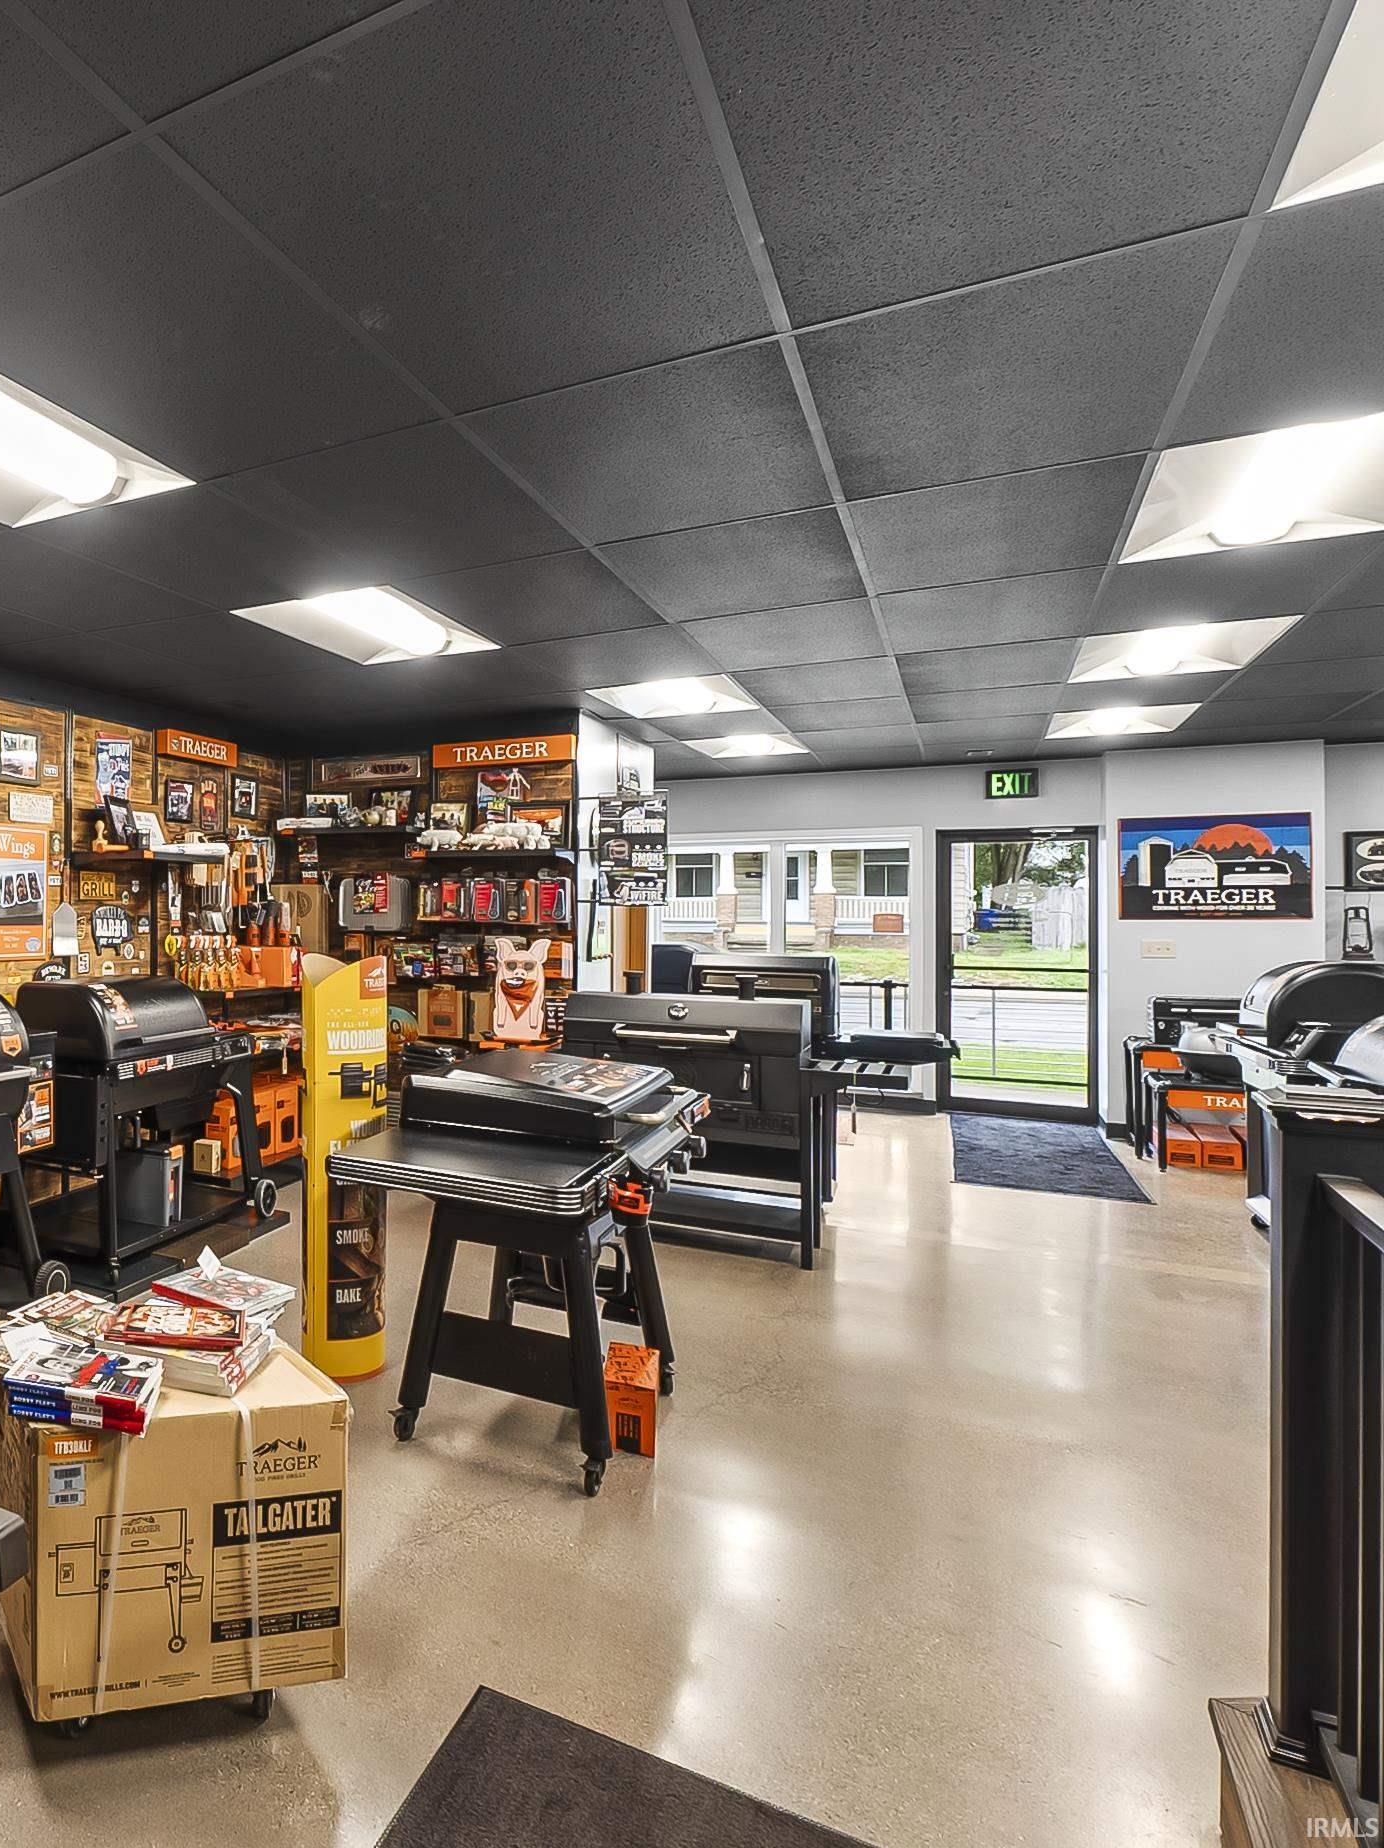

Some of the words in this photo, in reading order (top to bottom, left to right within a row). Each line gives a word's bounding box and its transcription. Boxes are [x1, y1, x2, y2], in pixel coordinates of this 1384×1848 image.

[179, 736, 228, 761] TRAEGER
[452, 741, 549, 764] TRAEGER
[991, 772, 1032, 797] EXIT
[81, 881, 114, 898] GRILL
[1152, 888, 1276, 905] TRAEGER
[336, 1227, 370, 1245] SMOKE
[335, 1287, 362, 1304] BAKE
[224, 1497, 334, 1538] TALGATER
